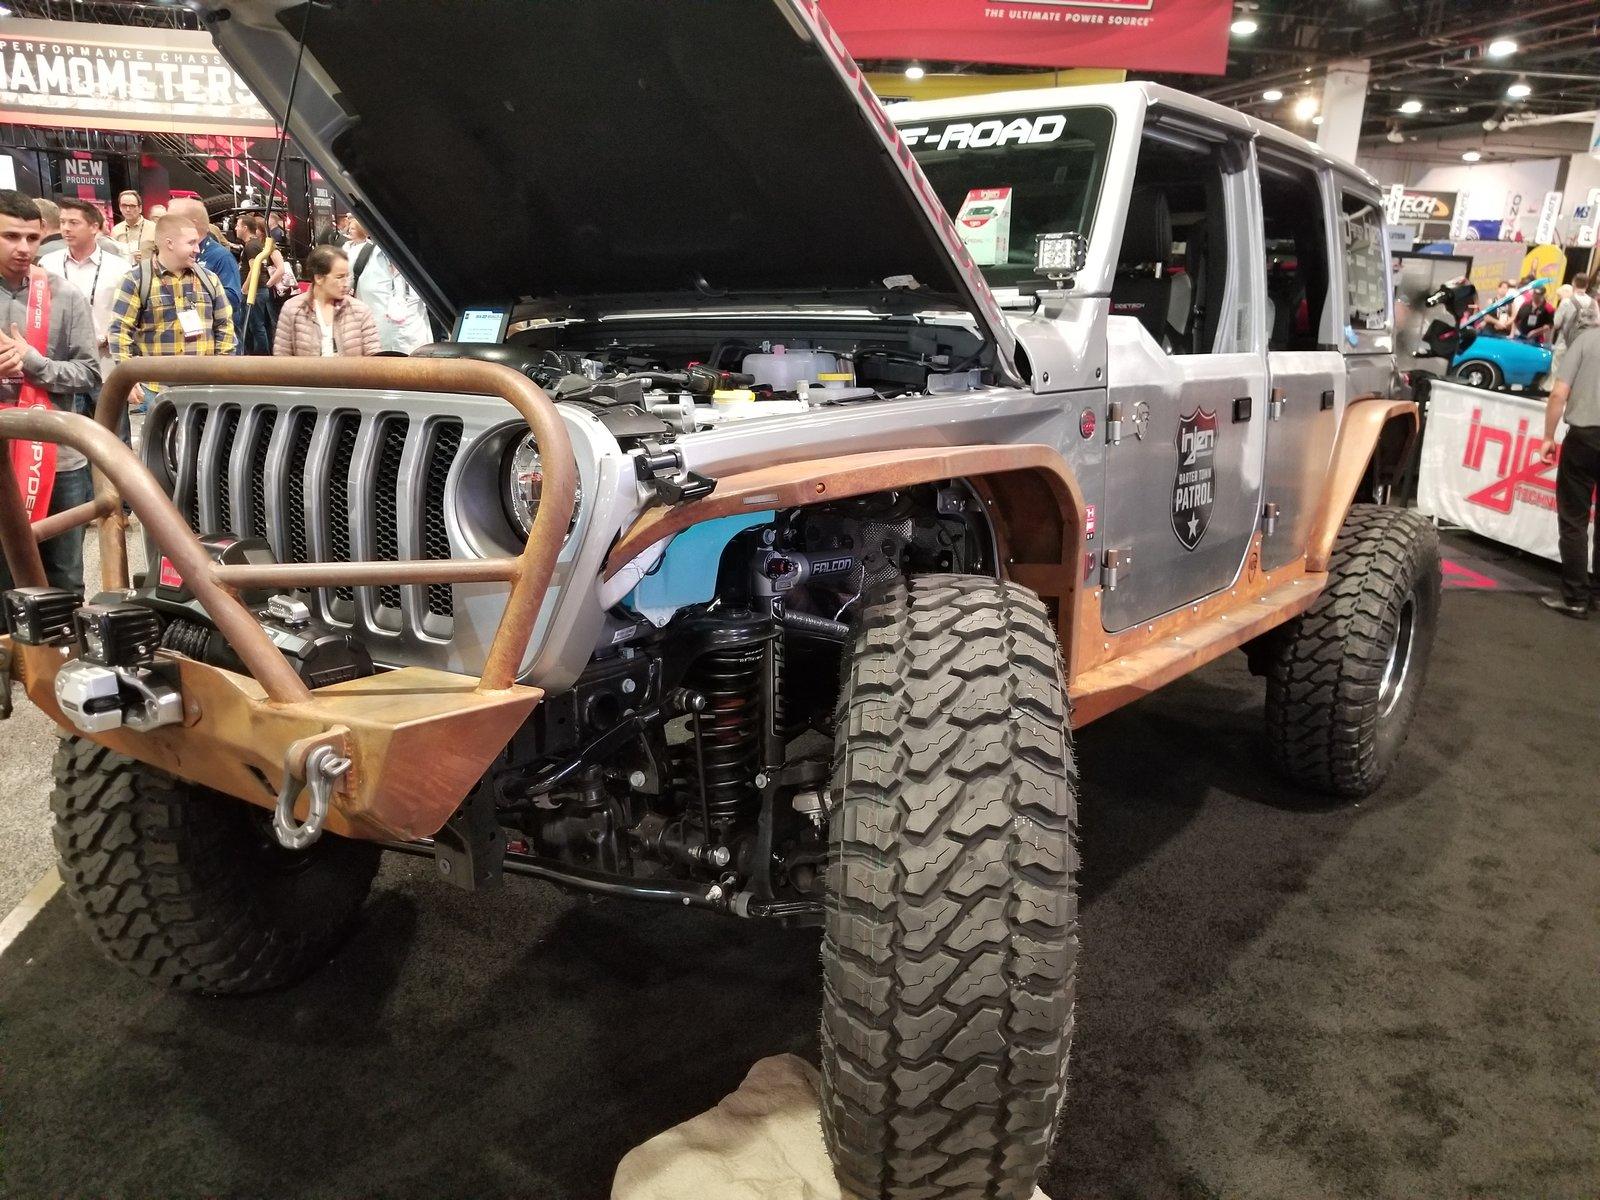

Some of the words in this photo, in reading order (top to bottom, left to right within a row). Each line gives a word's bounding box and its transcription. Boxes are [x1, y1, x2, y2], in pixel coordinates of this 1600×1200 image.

[985, 9, 1003, 18] THE
[1009, 11, 1060, 21] ULTIMATE
[1065, 13, 1104, 24] POWER
[0, 41, 144, 61] PERFORMANCE
[161, 53, 221, 65] CHASS
[0, 52, 258, 105] AMOMETERS
[897, 115, 1067, 151] F-ROAD
[65, 158, 103, 176] NEW
[66, 176, 105, 186] PRODUCTS
[1181, 425, 1214, 466] injen
[1462, 408, 1562, 515] inje
[25, 441, 43, 520] PYDE
[1175, 481, 1213, 513] PATROL
[1515, 487, 1558, 512] TECHN
[812, 559, 852, 575] FALCON
